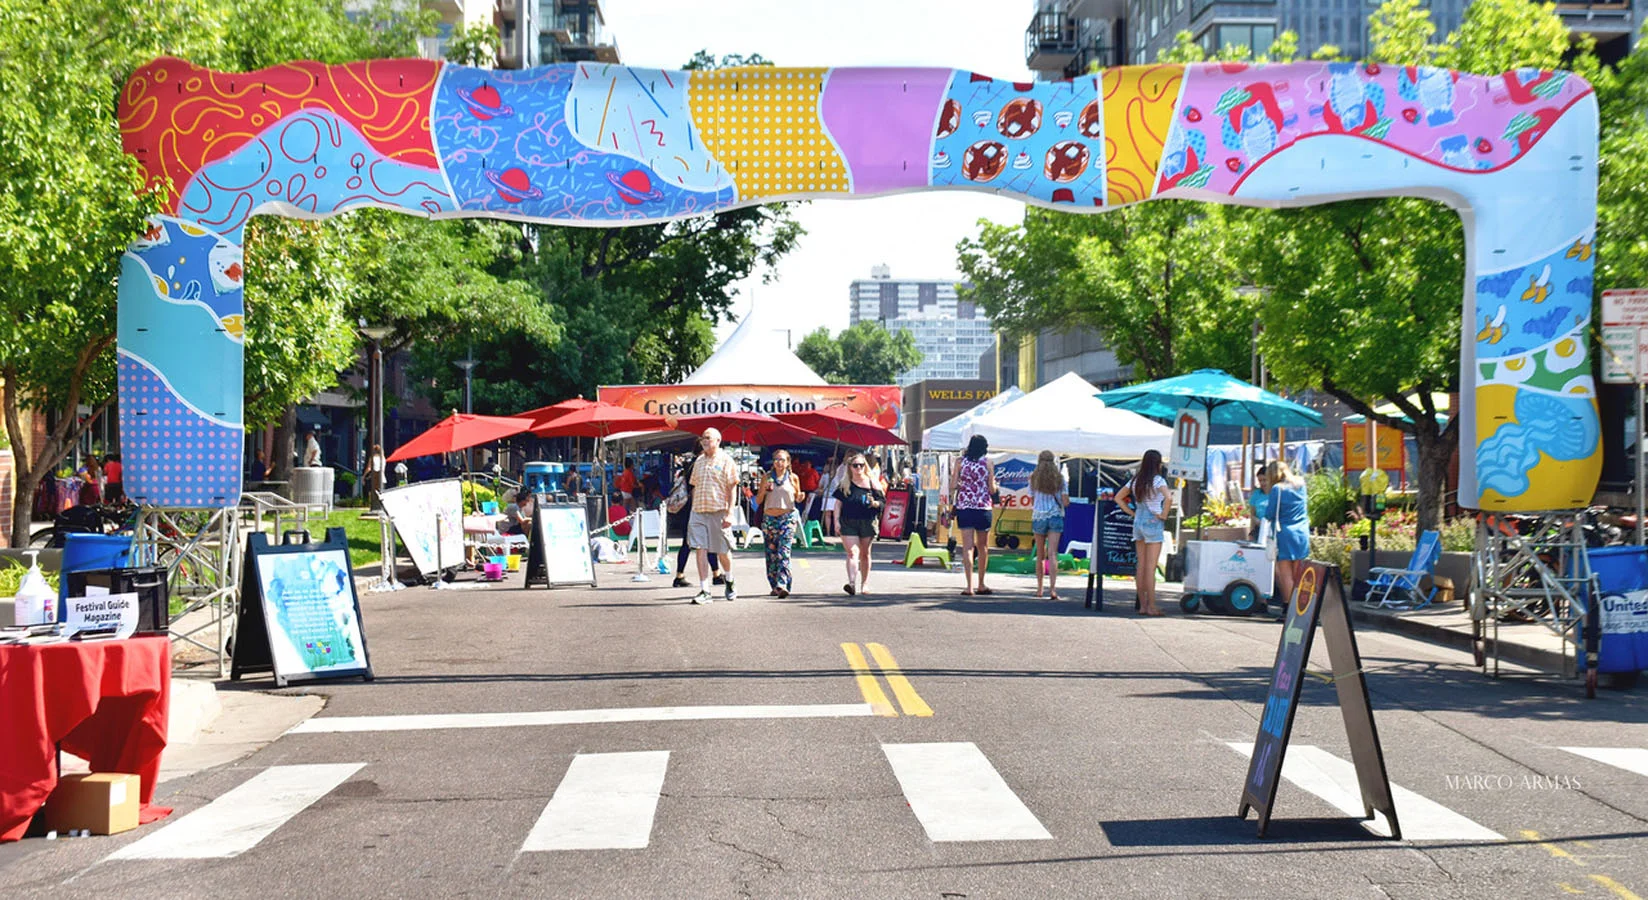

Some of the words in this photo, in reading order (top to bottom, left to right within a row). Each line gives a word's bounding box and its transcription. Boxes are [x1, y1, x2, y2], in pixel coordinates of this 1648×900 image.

[929, 389, 973, 400] WELLS
[643, 397, 732, 416] Creation
[740, 397, 816, 415] Station
[75, 601, 107, 612] Festival
[107, 600, 130, 610] Guide
[83, 612, 122, 624] Magazine
